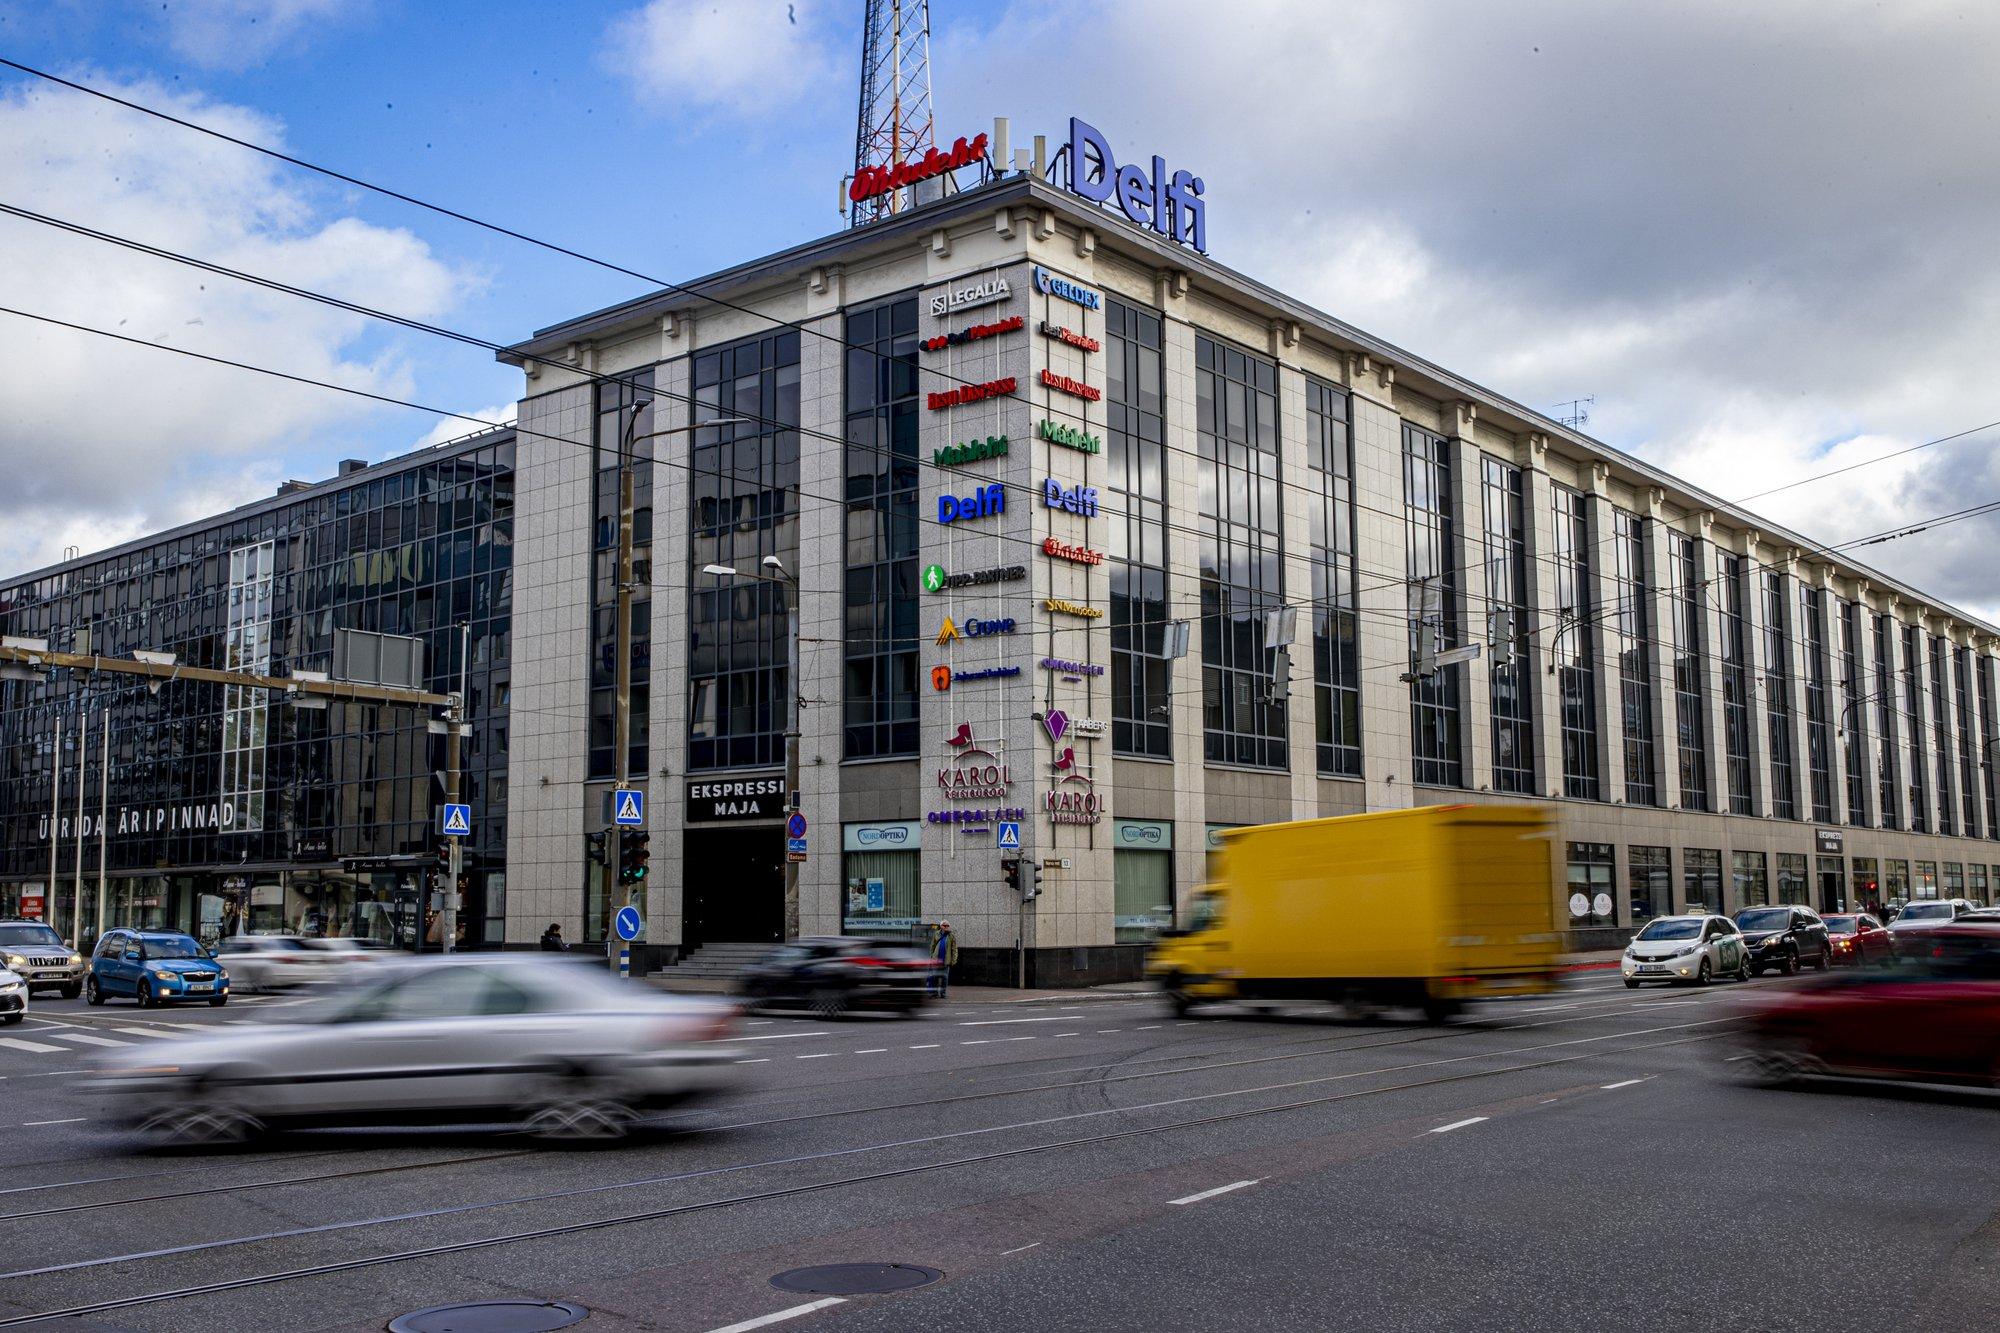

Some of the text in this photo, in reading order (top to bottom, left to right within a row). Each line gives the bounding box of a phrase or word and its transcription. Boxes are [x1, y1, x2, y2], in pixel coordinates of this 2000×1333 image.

[1070, 117, 1206, 253] Delfi
[949, 279, 1010, 306] LEGALIA
[1051, 277, 1100, 310] GELDEX
[938, 483, 1005, 523] Delfi
[1045, 477, 1098, 518] Delfi
[965, 618, 1016, 637] Crowe
[691, 780, 785, 799] EKSPRESSI
[938, 765, 1014, 788] KAROL
[714, 800, 760, 816] MAJA
[1046, 790, 1106, 813] KAROL
[117, 802, 234, 834] ÄRIPINNAD
